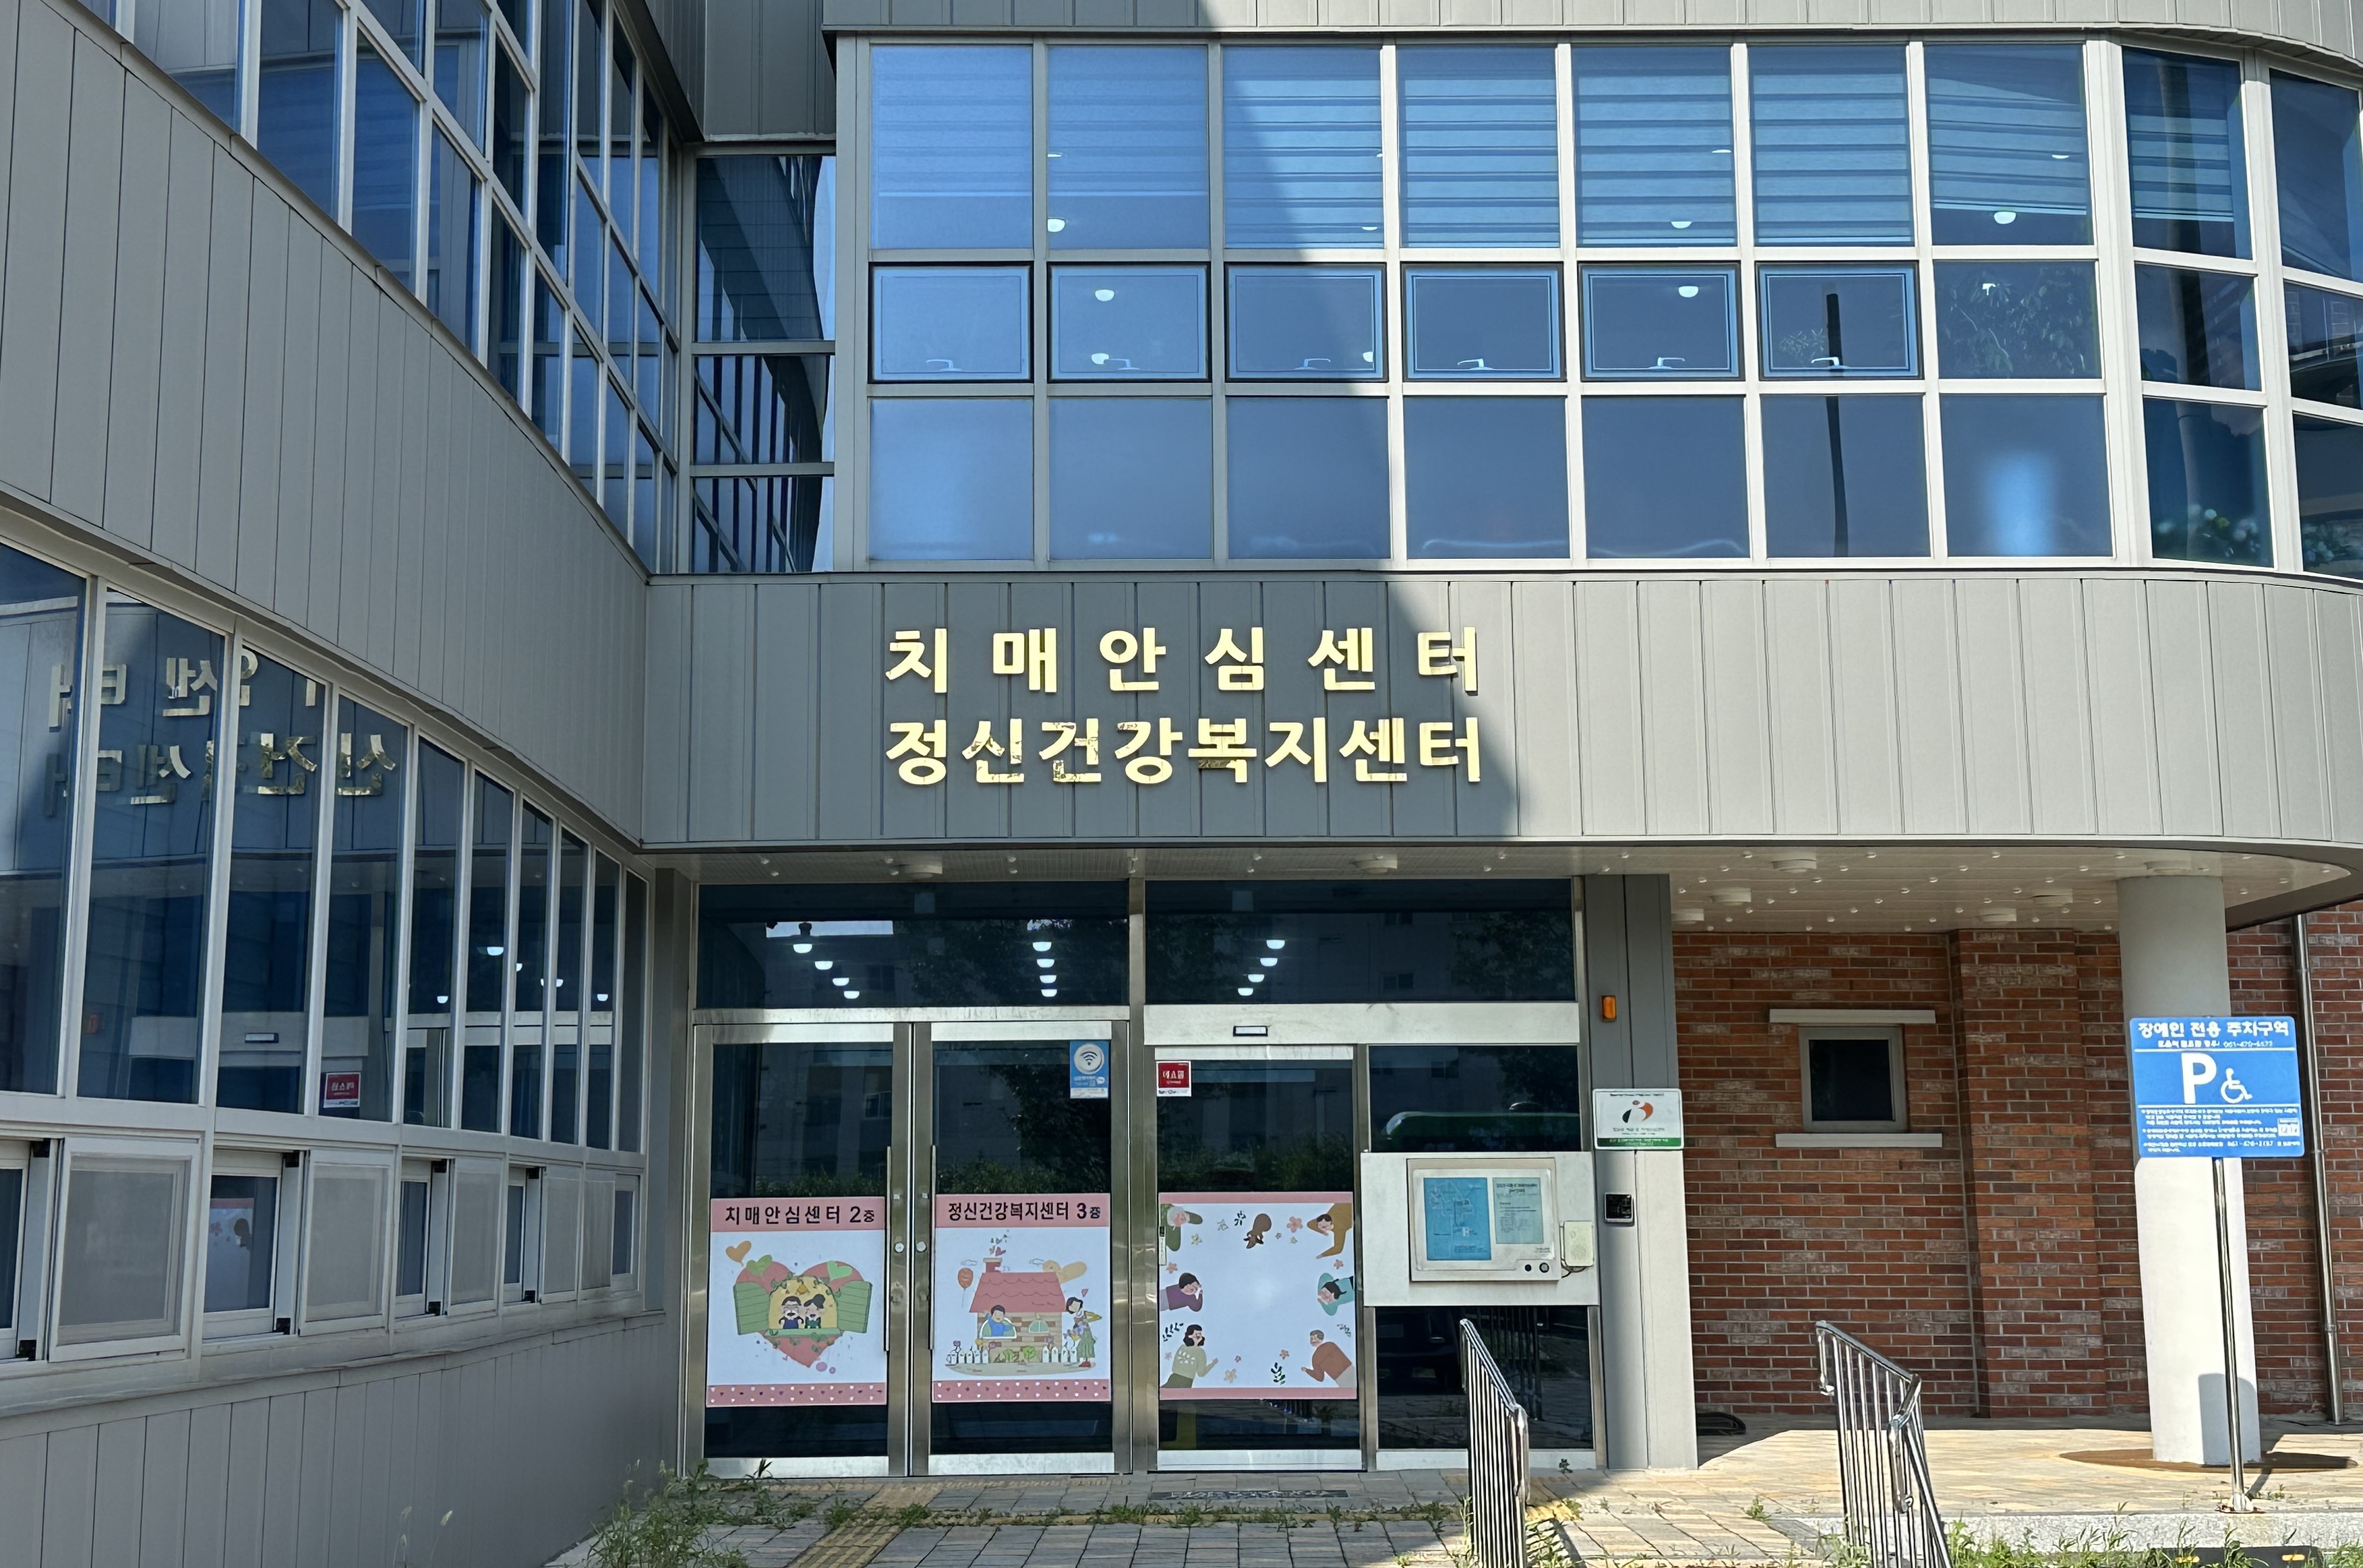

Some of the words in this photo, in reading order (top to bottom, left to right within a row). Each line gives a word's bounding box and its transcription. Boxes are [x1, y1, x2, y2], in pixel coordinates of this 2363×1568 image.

[886, 717, 1481, 785] 정신건강복지센터
[2138, 1022, 2185, 1039] 장애인
[2190, 1022, 2221, 1038] 전용
[2226, 1021, 2290, 1037] 주차구역
[2181, 1052, 2217, 1104] P
[948, 1202, 1069, 1221] 정신건강복지센터
